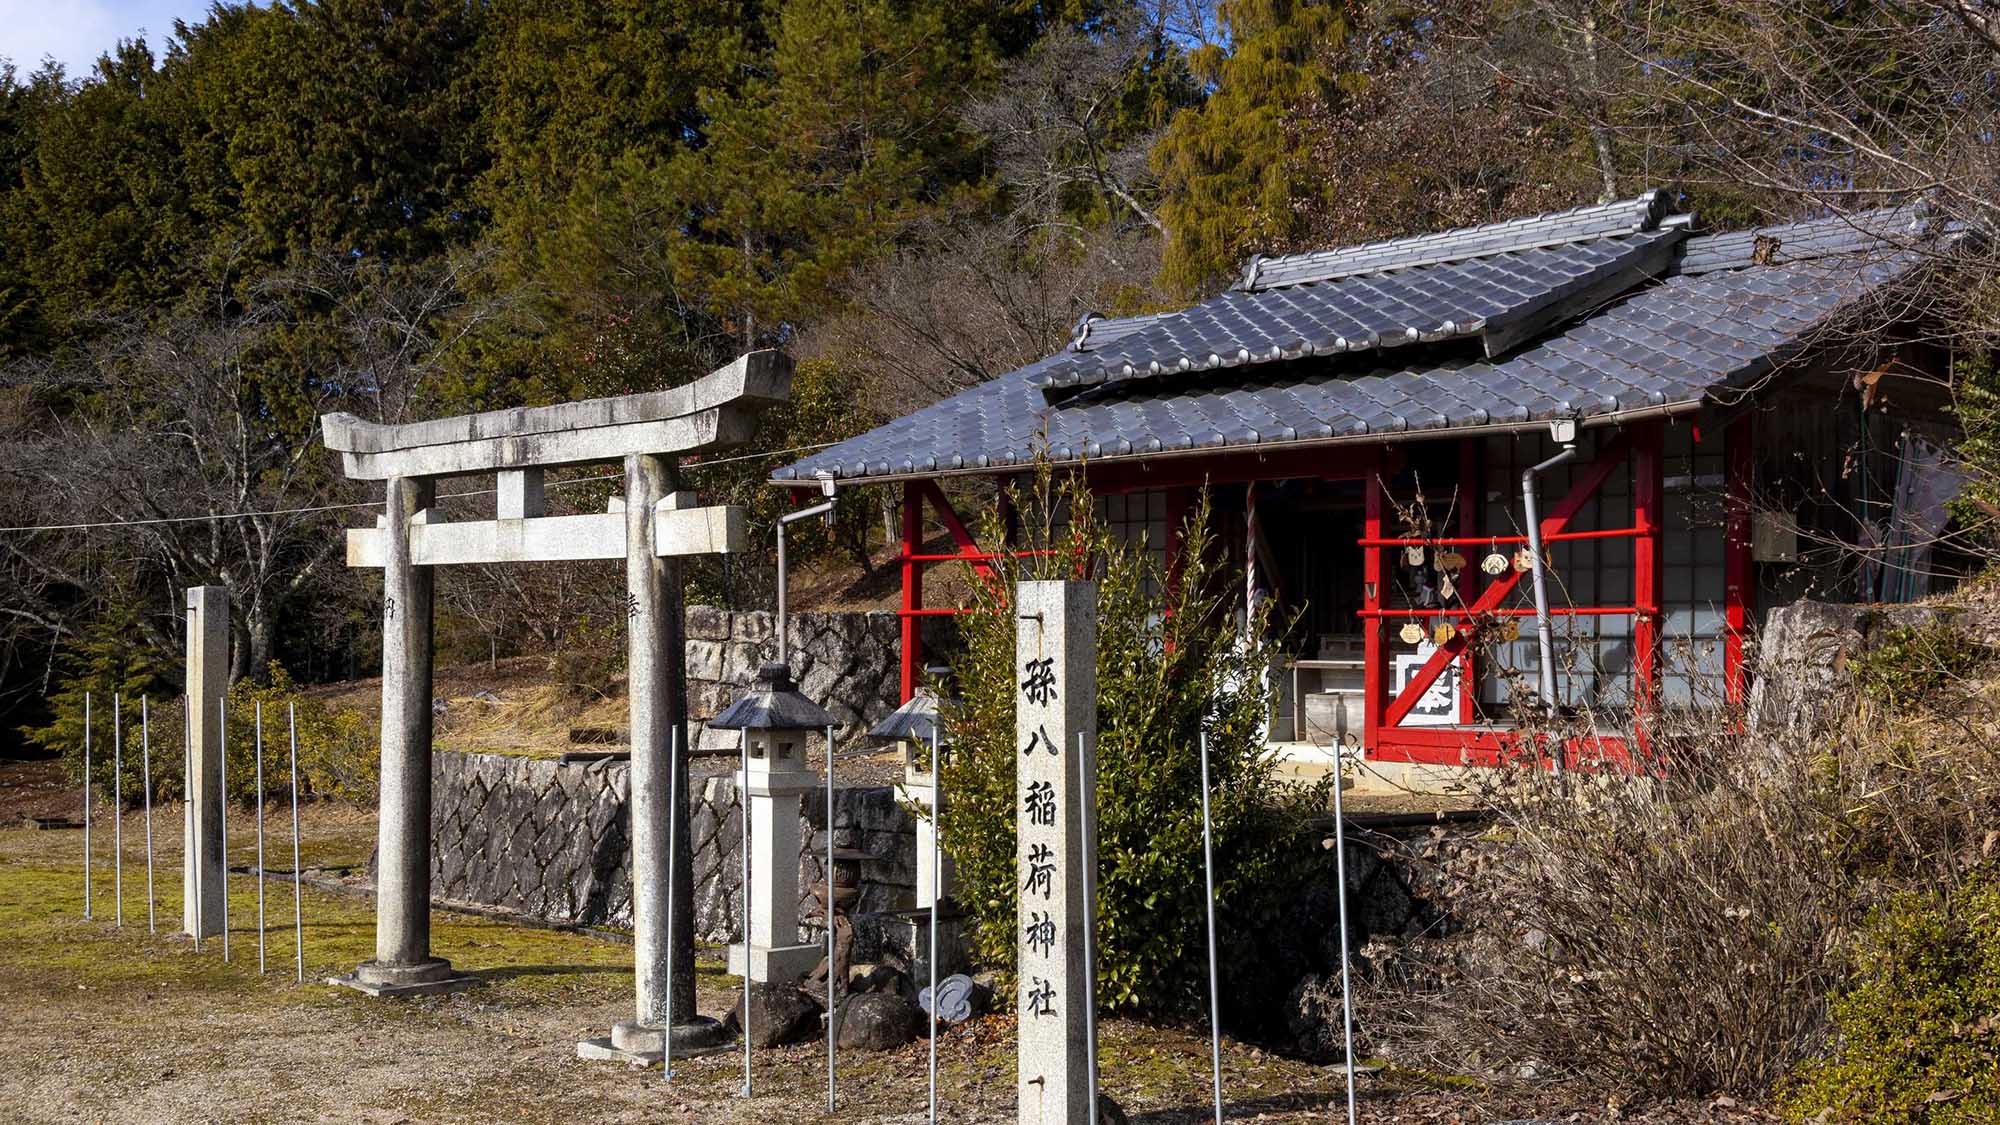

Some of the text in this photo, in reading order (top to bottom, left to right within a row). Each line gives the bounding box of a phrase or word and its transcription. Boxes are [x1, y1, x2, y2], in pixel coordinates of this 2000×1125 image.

[1021, 657, 1058, 1020] 孫八稲荷神社
